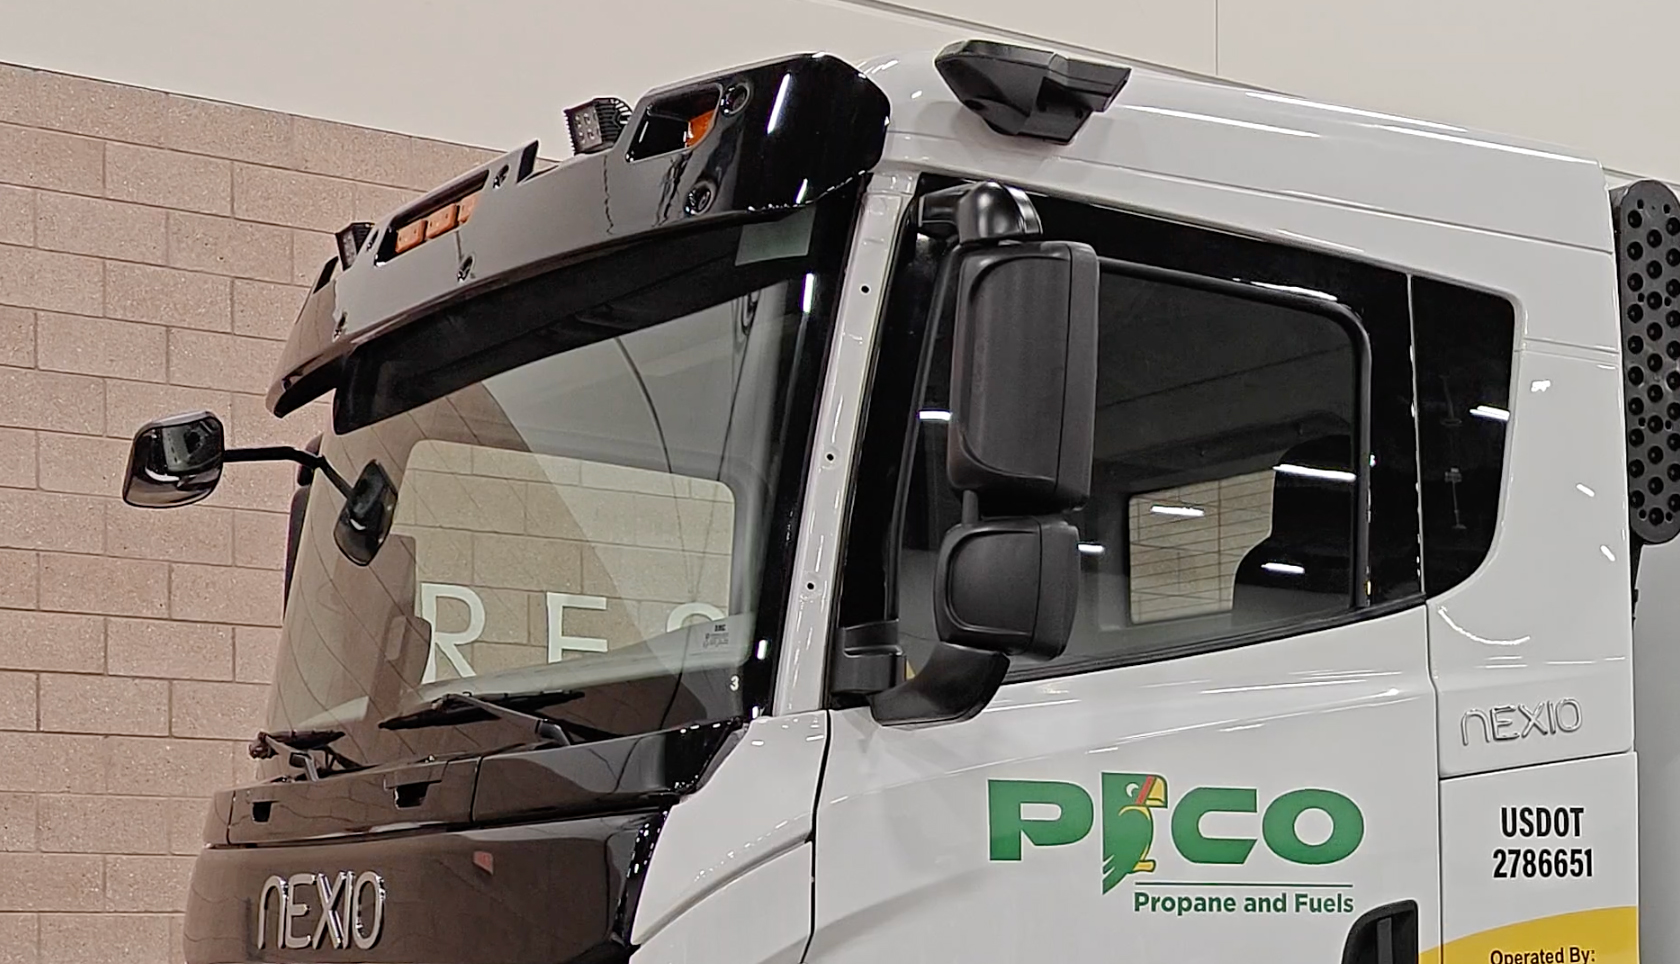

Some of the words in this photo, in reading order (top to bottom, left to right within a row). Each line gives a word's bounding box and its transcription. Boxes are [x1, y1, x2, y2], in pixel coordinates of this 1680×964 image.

[730, 675, 739, 691] 3
[987, 771, 1365, 896] PICO
[1500, 806, 1585, 837] USDOT
[1492, 848, 1593, 878] 2786651
[1133, 892, 1237, 916] Propane
[1244, 892, 1287, 913] and
[1294, 892, 1354, 914] Fuels
